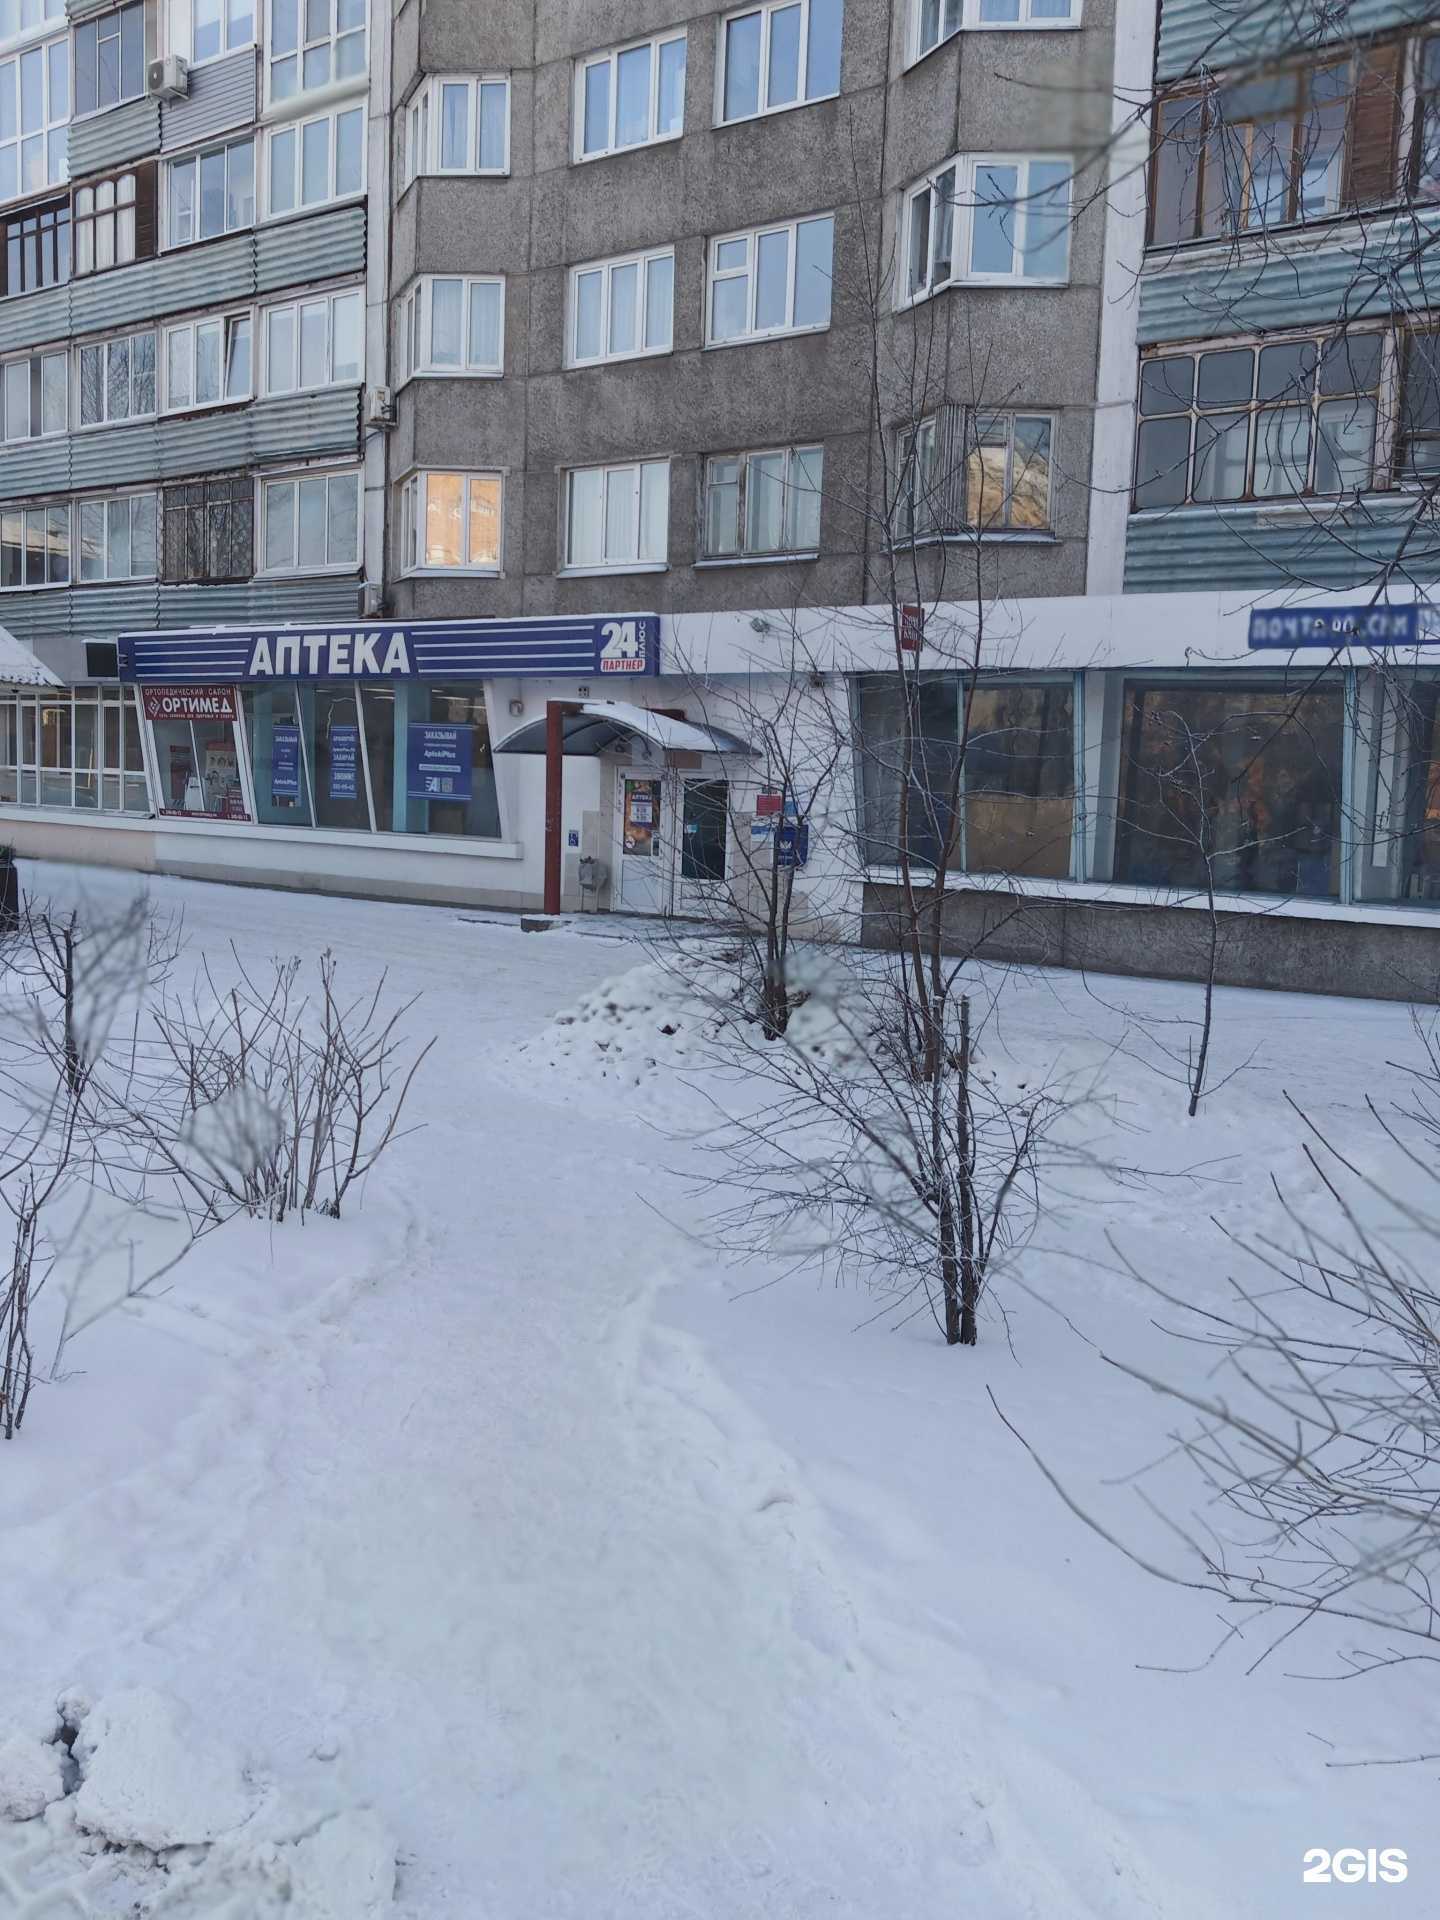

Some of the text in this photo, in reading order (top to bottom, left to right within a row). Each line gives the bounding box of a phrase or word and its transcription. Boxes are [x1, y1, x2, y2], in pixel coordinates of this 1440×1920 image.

[600, 621, 638, 659] 24
[249, 633, 411, 676] АПТЕКА
[602, 659, 643, 671] ПАРТНЕР
[145, 688, 231, 696] ОРТОПЕДИЧЕСКИЙ САЛОН
[162, 697, 233, 713] ОРТИМЕД
